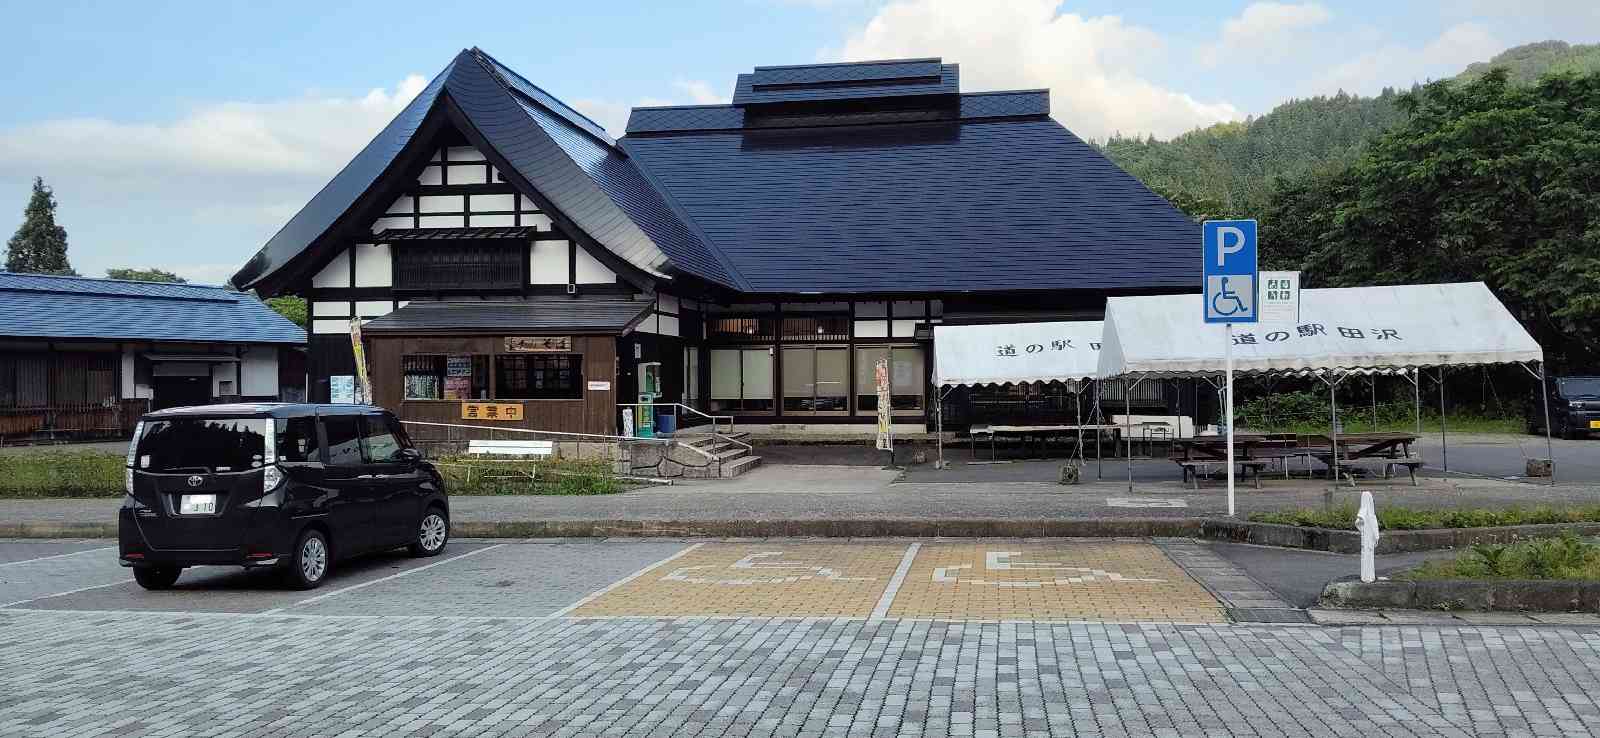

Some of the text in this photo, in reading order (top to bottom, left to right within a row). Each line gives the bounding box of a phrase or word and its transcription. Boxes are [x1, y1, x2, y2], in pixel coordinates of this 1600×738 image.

[1217, 226, 1246, 267] P
[467, 405, 517, 419] 営業中
